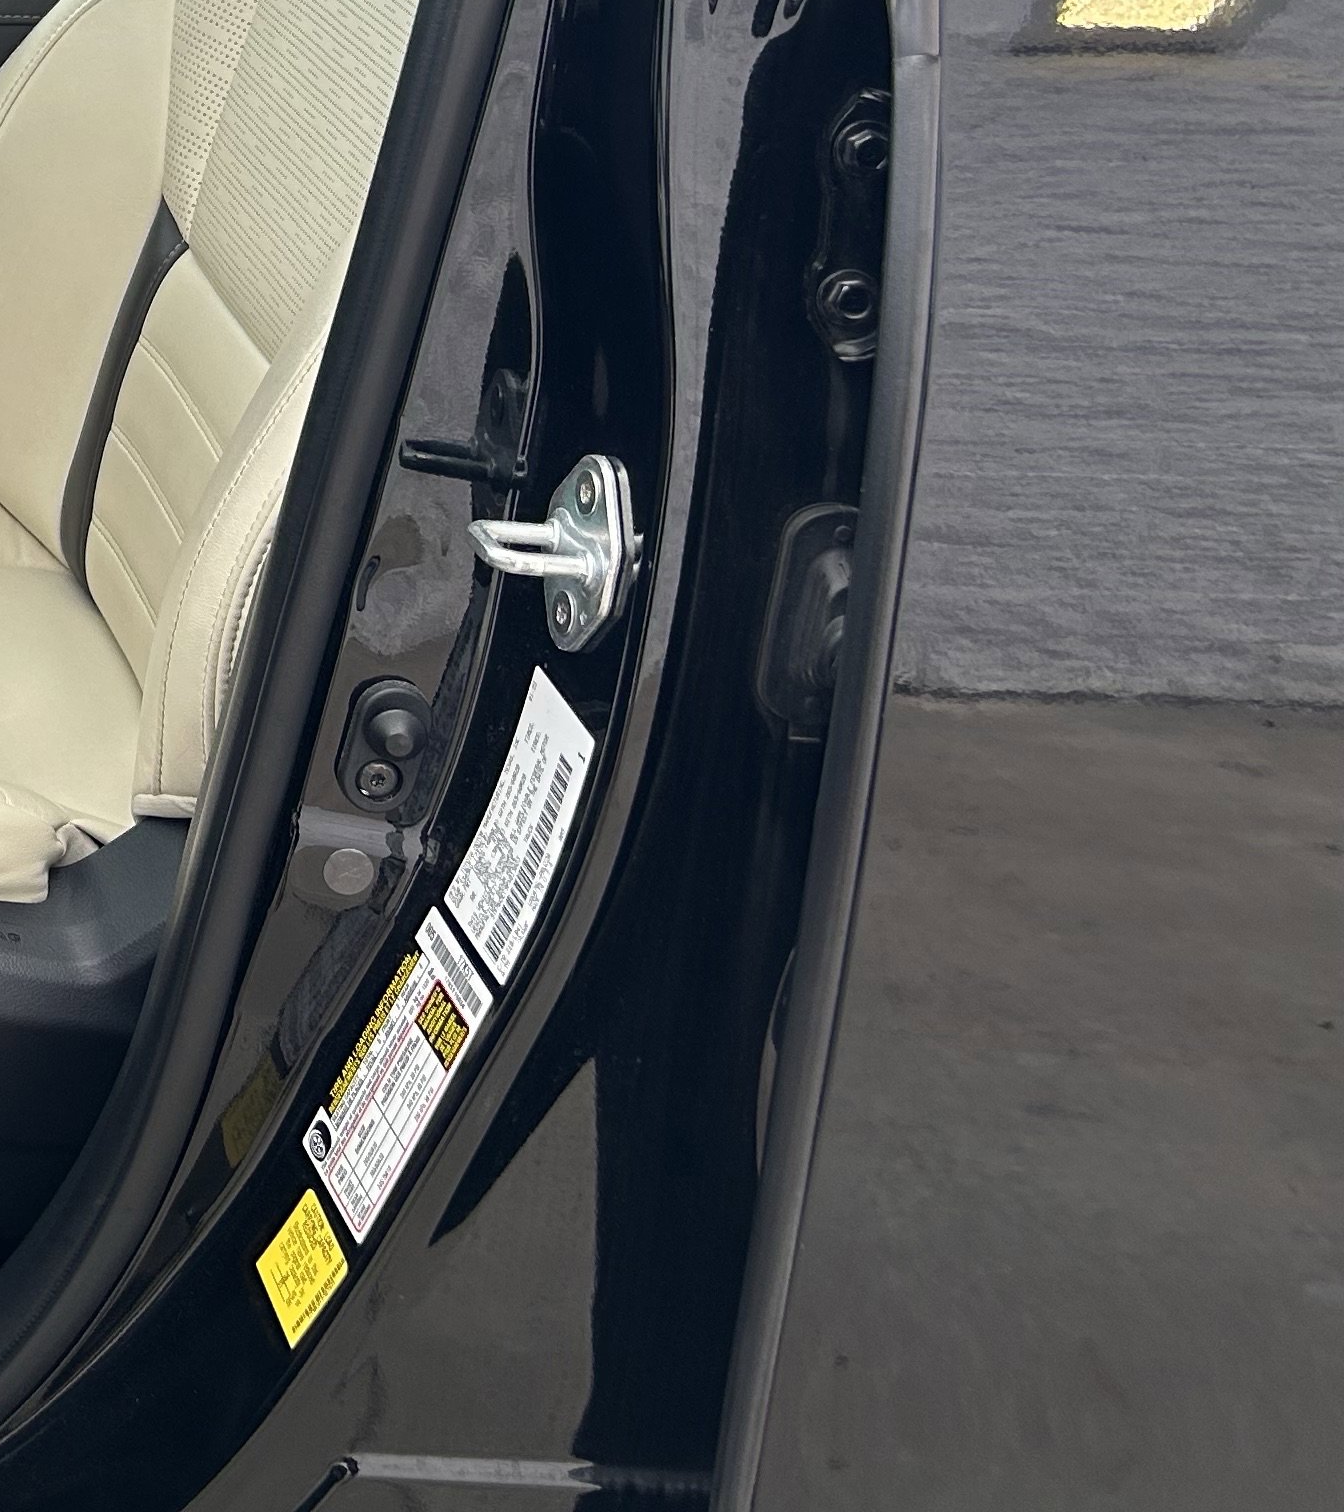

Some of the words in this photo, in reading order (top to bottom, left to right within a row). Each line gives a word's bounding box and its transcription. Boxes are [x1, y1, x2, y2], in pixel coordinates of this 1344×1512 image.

[340, 1054, 354, 1078] AND
[351, 1014, 376, 1058] LOADING
[374, 951, 412, 1018] INFORMATION
